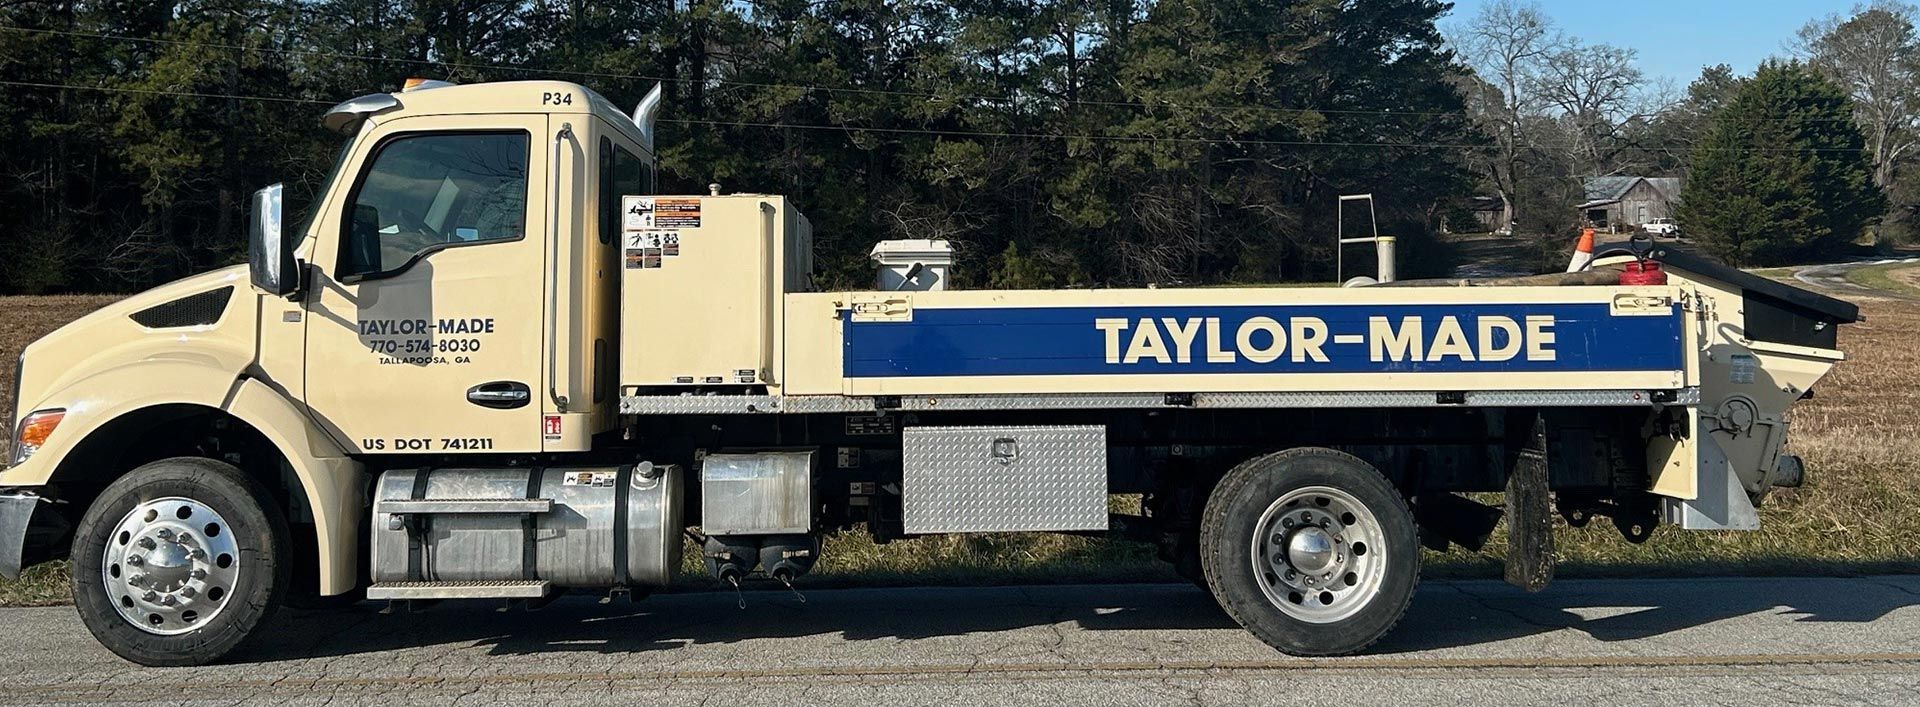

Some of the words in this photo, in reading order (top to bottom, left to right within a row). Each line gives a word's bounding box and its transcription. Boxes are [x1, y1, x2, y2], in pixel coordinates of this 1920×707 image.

[543, 92, 572, 105] P34
[359, 318, 494, 335] TAYLOR-MADE
[370, 339, 481, 353] 770-574-8030
[1095, 315, 1556, 364] TAYLOR-MADE
[379, 356, 450, 365] TALLAPOOSA,
[454, 356, 471, 364] GA
[363, 438, 385, 450] US
[394, 438, 432, 450] DOT
[441, 438, 493, 450] 741211
